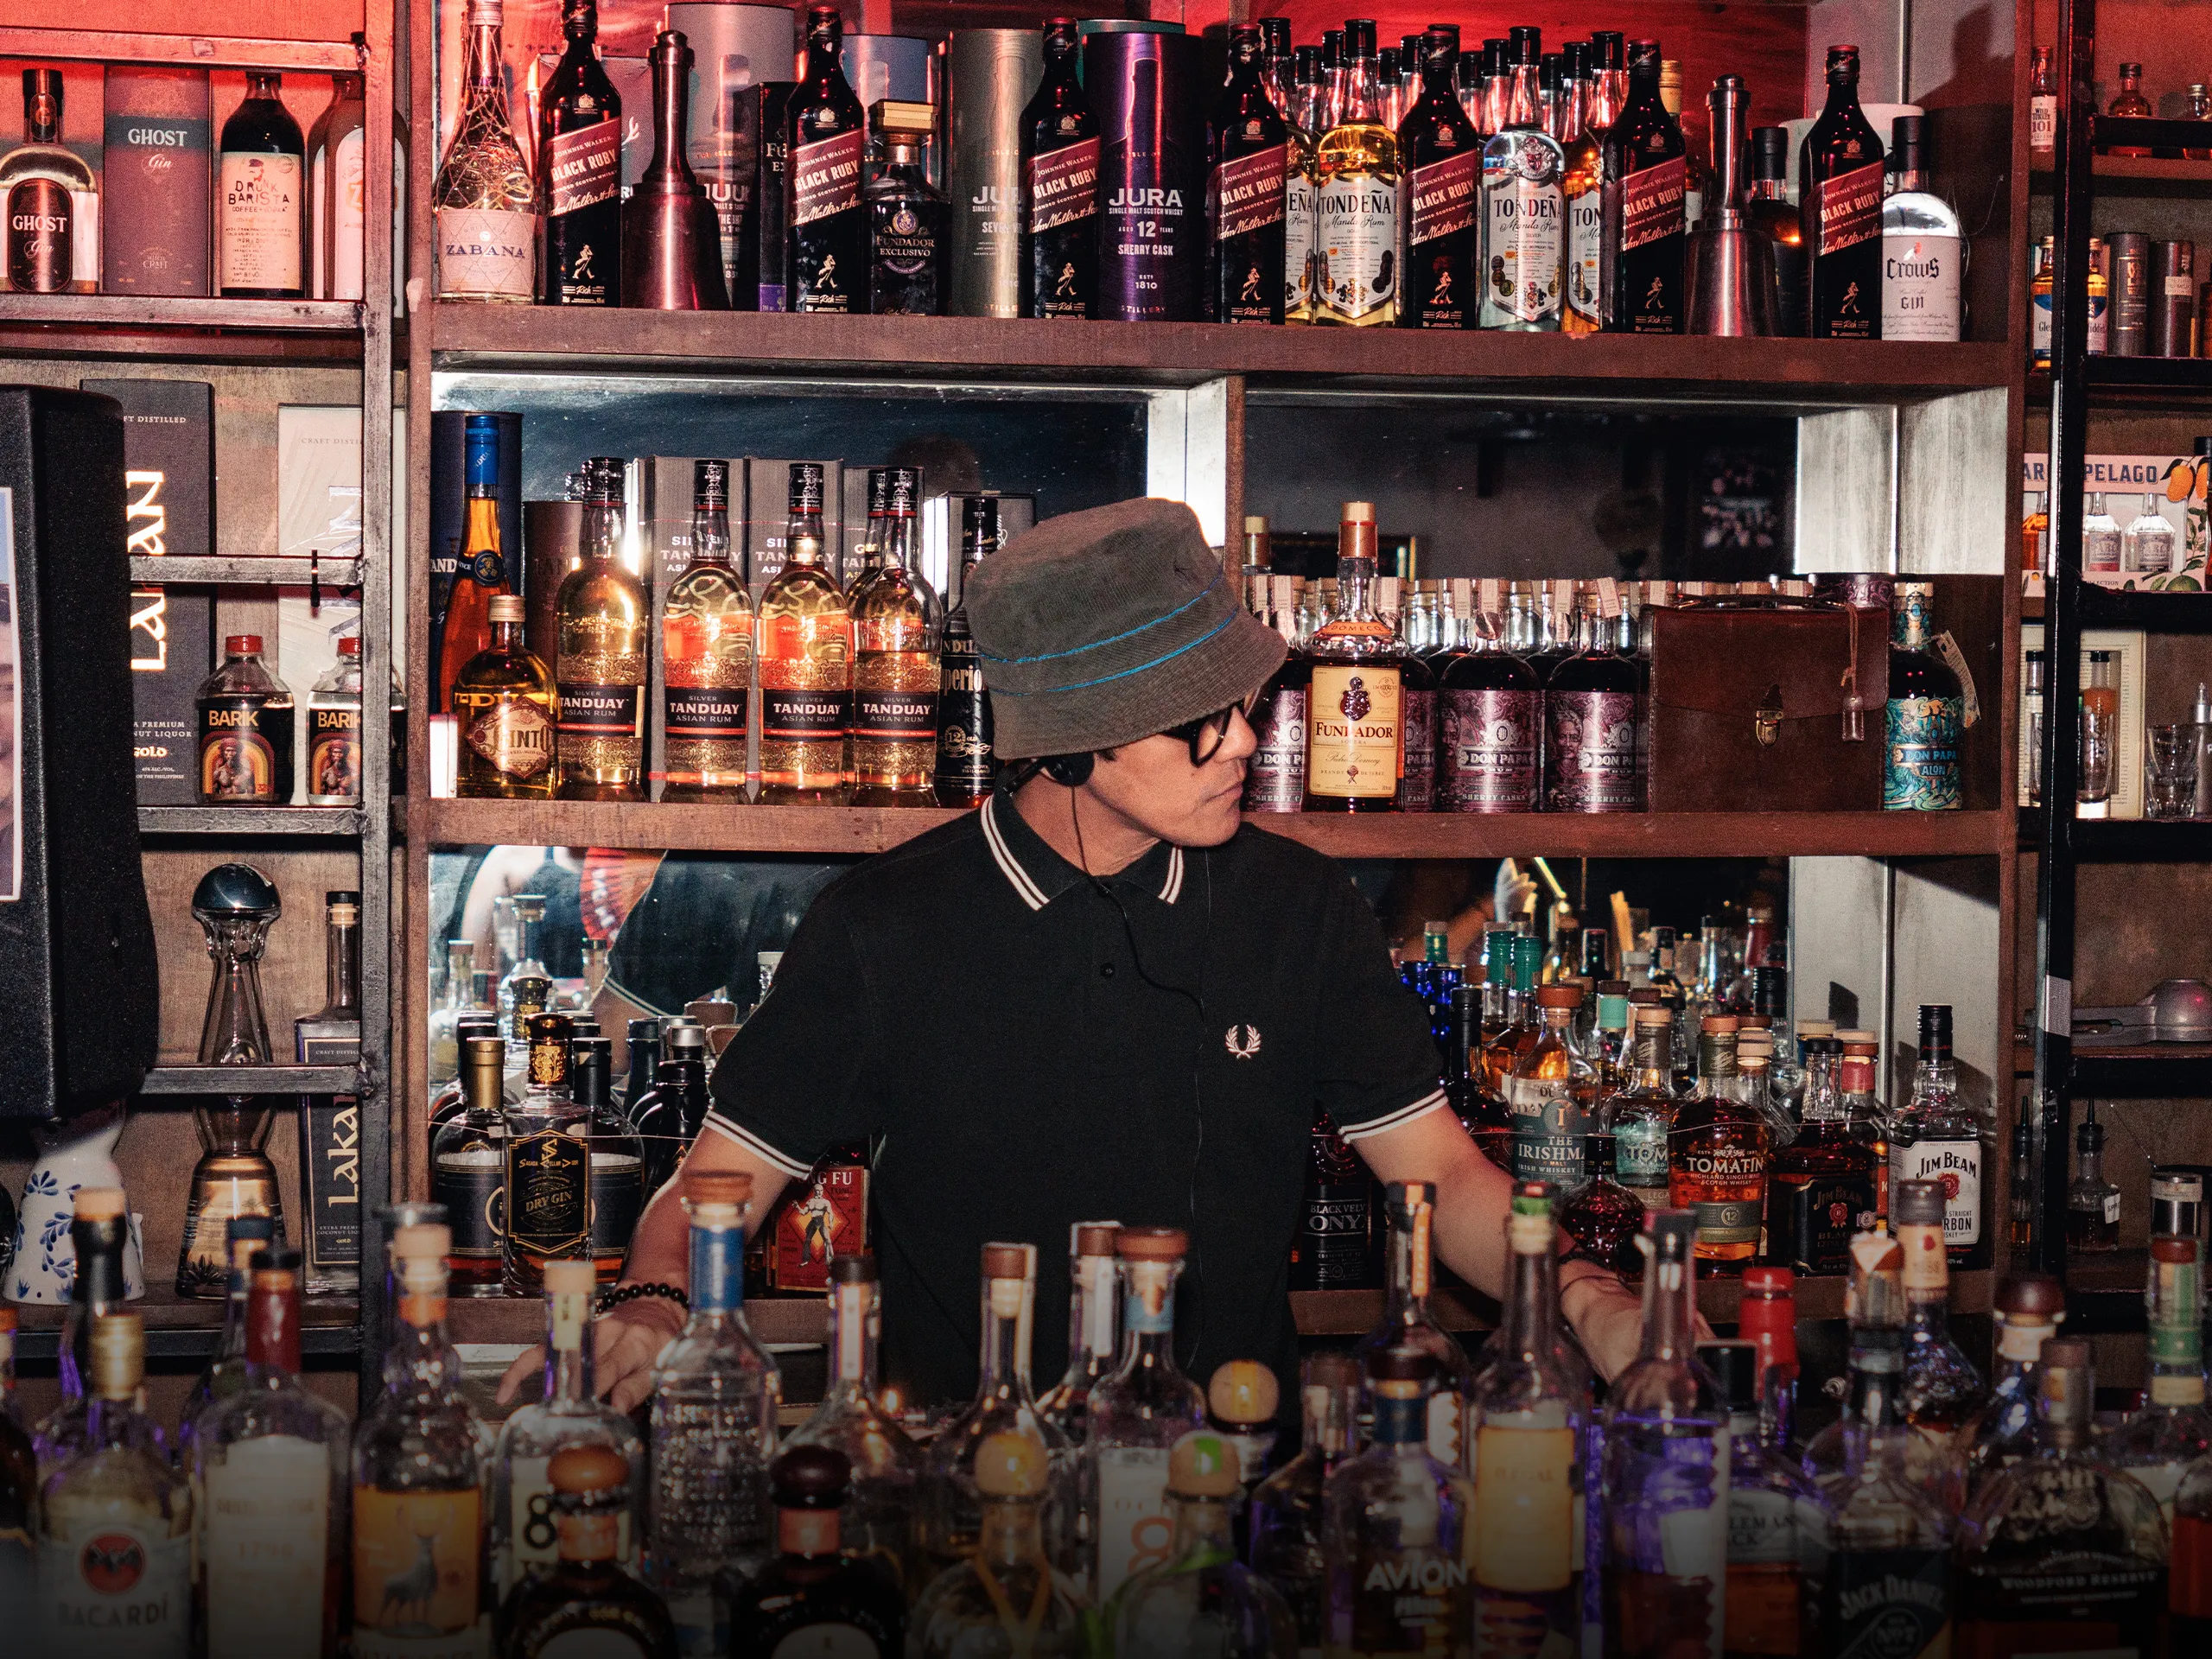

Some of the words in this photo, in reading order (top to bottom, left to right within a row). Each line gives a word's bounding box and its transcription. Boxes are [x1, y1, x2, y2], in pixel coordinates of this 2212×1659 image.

[2032, 121, 2051, 132] 101
[128, 128, 188, 147] GHOST
[554, 146, 584, 161] JOHNNIE
[141, 154, 173, 173] Gin
[550, 160, 587, 183] BLACK
[587, 148, 616, 170] RUBY
[798, 156, 828, 171] JOHNNIE
[1037, 163, 1065, 178] JOHNNIE
[794, 170, 830, 193] BLACK
[830, 159, 859, 179] RUBY
[1224, 170, 1252, 185] JOHNNIE
[1415, 175, 1444, 190] JOHNNIE
[234, 179, 278, 193] DRUNK
[1033, 177, 1068, 200] BLACK
[1070, 168, 1097, 188] RUBY
[1220, 184, 1255, 207] BLACK
[1256, 175, 1283, 194] RUBY
[1628, 182, 1655, 196] JOHNNIE
[228, 191, 290, 206] BARISTA
[1109, 188, 1183, 207] JURA
[1320, 190, 1391, 214] TONDEÑA
[1413, 189, 1445, 212] BLACK
[1447, 180, 1474, 200] RUBY
[1624, 194, 1656, 217] BLACK
[1658, 185, 1684, 205] RUBY
[1824, 188, 1850, 201] JOHNNIE
[1494, 194, 1562, 219] TONDEÑA
[1821, 201, 1853, 223] BLACK
[1853, 190, 1880, 211] RUBY
[12, 215, 67, 233] GHOST
[1137, 220, 1156, 238] 12
[1360, 215, 1385, 228] Rum
[876, 235, 934, 248] FUNDADOR
[446, 244, 525, 259] ZABANA
[880, 247, 931, 257] EXCLUSIVO
[1118, 244, 1150, 256] SHERRY
[1152, 244, 1173, 257] CASK
[1135, 281, 1158, 289] 1810
[138, 415, 187, 423] DISTILLED
[660, 550, 741, 562] TANY
[755, 551, 836, 563] TANY
[125, 471, 167, 671] LAAN
[1331, 624, 1383, 632] DOMECQ
[940, 668, 984, 695] perio
[560, 697, 625, 709] TANDUAY
[670, 702, 740, 715] TANDUAY
[773, 702, 840, 715] TANDUAY
[863, 703, 931, 715] TANDUAY
[208, 709, 258, 727] BARIK
[1316, 721, 1394, 739] FUNADOR
[1263, 753, 1294, 765] DON
[1470, 753, 1498, 765] DON
[1499, 754, 1529, 765] PAPA
[1595, 755, 1620, 766] DON
[1905, 750, 1929, 760] DON
[1933, 750, 1957, 760] PAPA
[1922, 766, 1945, 776] ALON
[1548, 1136, 1573, 1146] THE
[327, 1096, 359, 1208] LAKA
[1518, 1143, 1586, 1160] IRISHM
[1518, 1163, 1535, 1172] IRISH
[1539, 1166, 1575, 1174] WHISKEY
[1686, 1156, 1764, 1173] TOMATIN
[1916, 1156, 1942, 1179] JIM
[1943, 1152, 1977, 1179] BEAM
[831, 1171, 852, 1185] FU
[525, 1196, 550, 1212] DRY
[550, 1191, 573, 1205] GIN
[1813, 1191, 1833, 1211] JIM
[1835, 1185, 1863, 1207] BEAM
[1310, 1205, 1342, 1214] BLACK
[1343, 1203, 1366, 1213] VELV
[1726, 1211, 1737, 1221] 12
[1943, 1217, 1972, 1230] RBON
